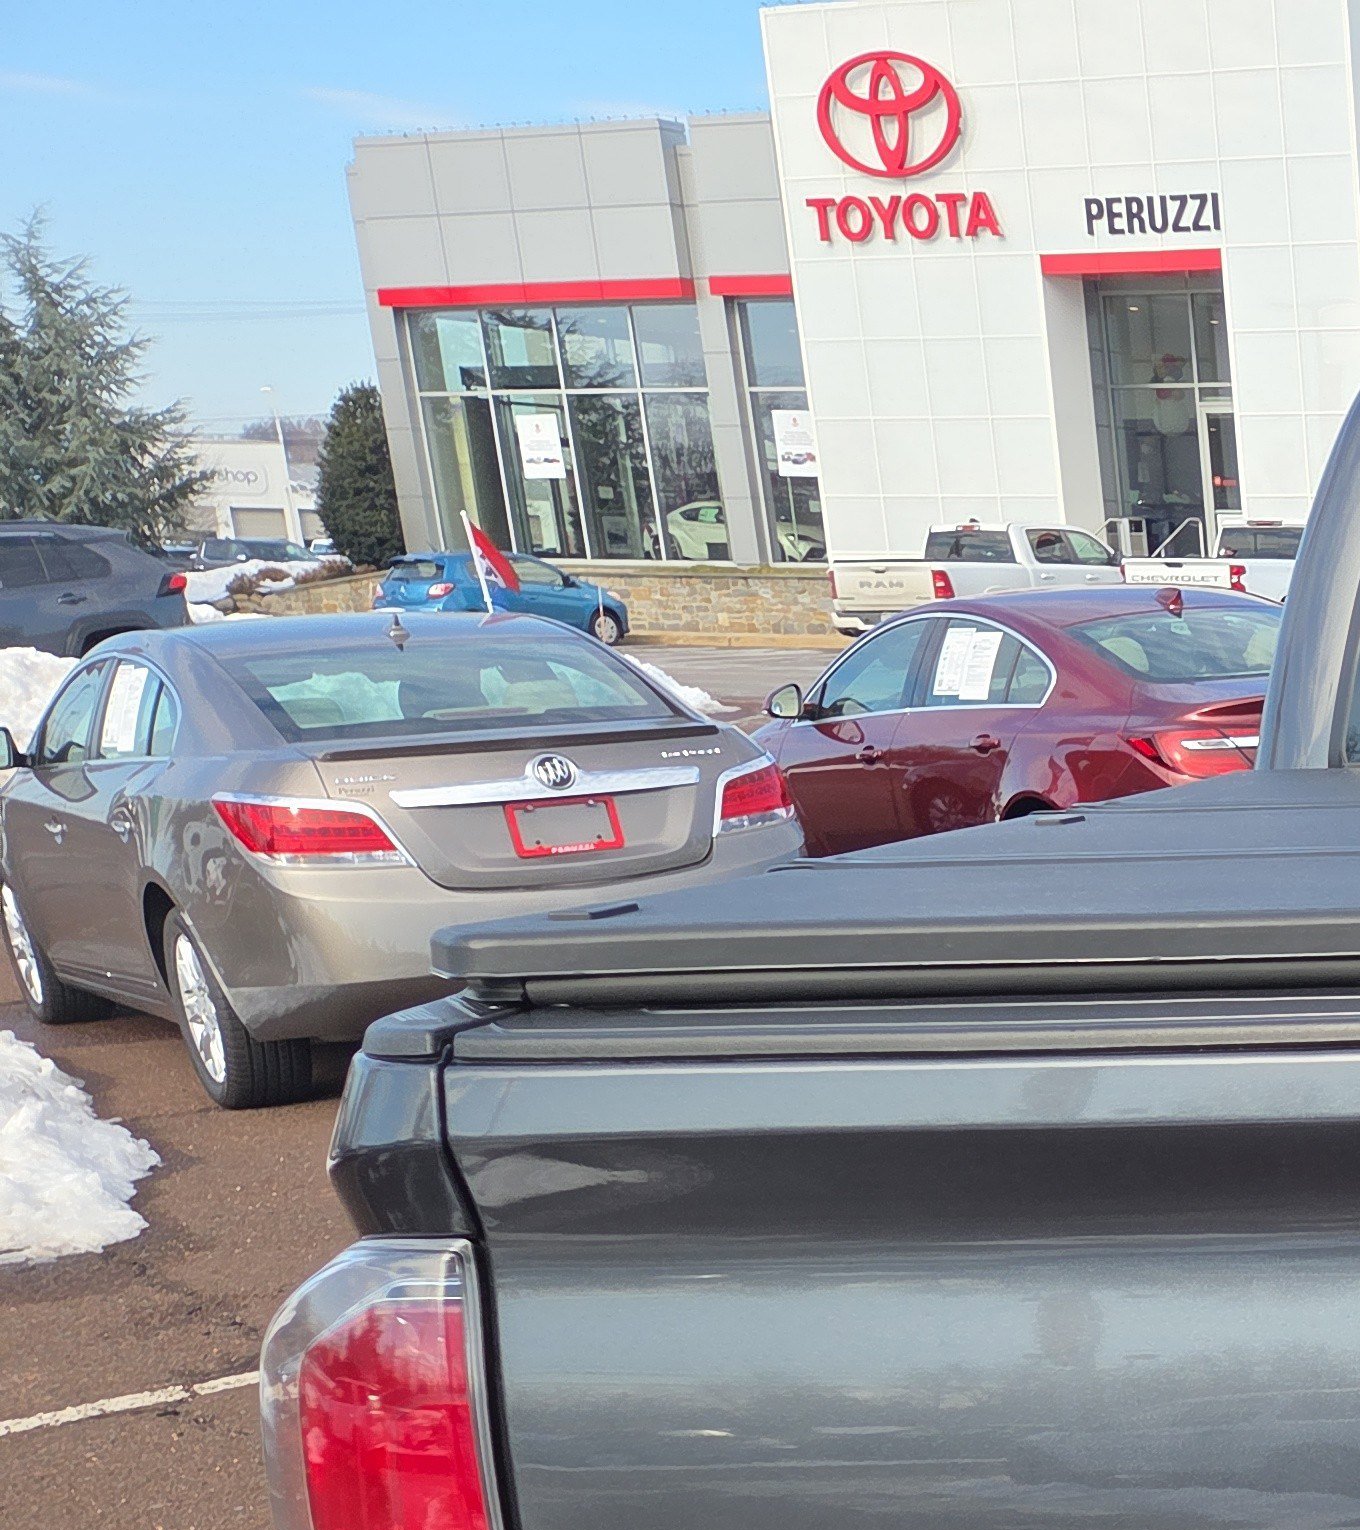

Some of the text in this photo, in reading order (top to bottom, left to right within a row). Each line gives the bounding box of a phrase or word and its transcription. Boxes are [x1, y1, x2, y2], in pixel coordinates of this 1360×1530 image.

[806, 192, 1002, 241] TOYOTA
[1085, 192, 1219, 236] PERUZZI
[858, 581, 904, 589] RAM
